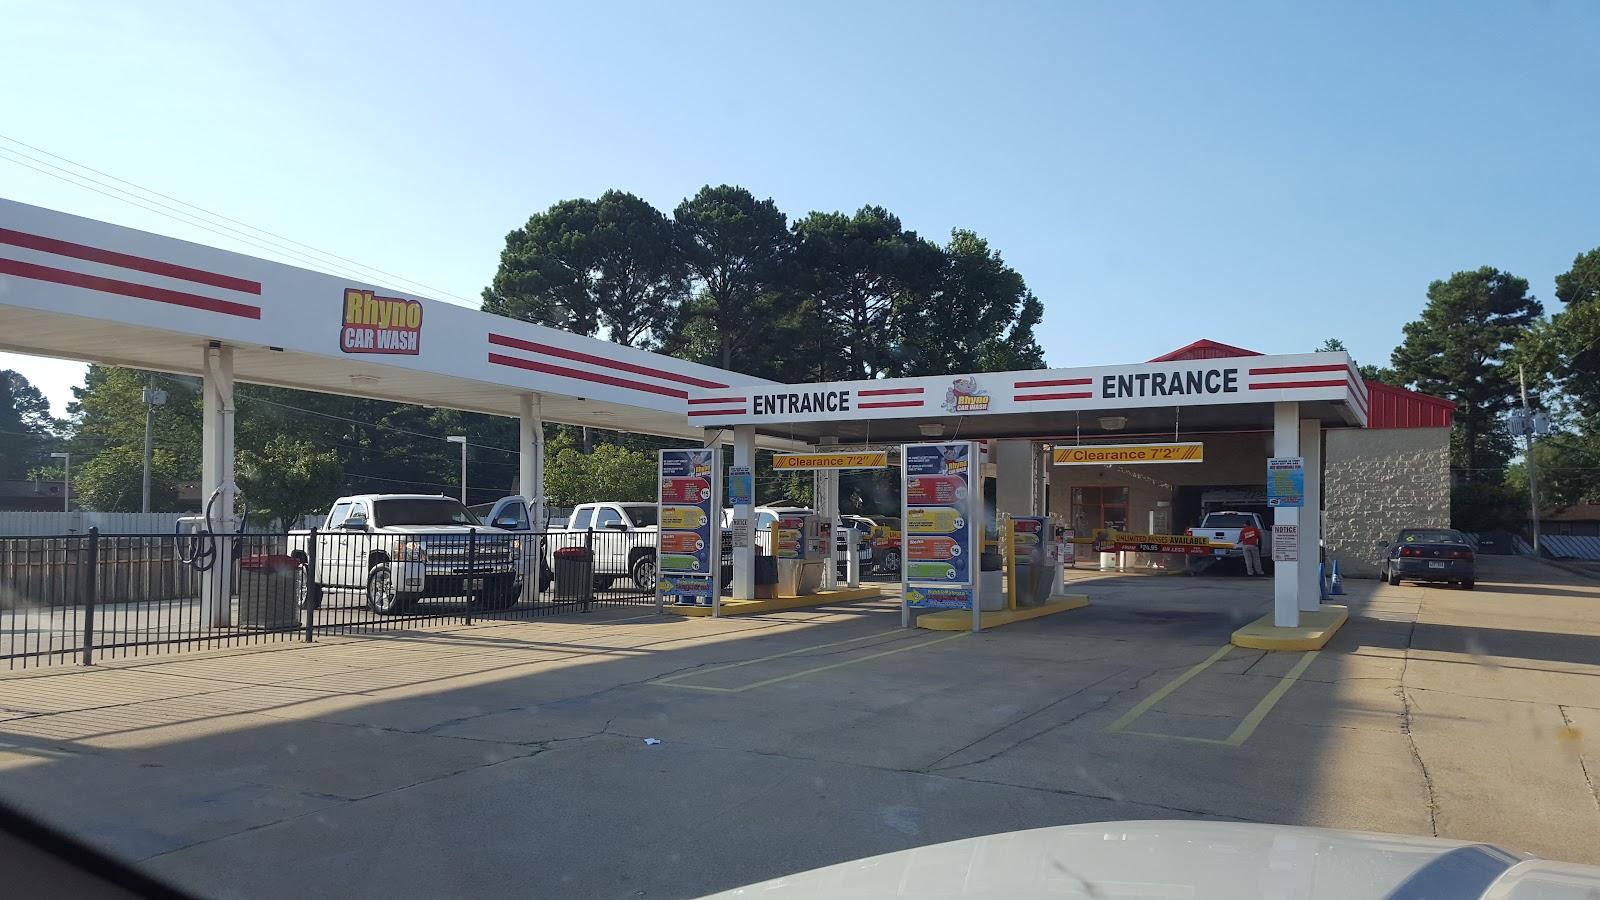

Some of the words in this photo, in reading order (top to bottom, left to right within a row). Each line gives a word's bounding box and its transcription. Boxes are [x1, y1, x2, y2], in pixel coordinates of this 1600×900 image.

[346, 291, 420, 329] Rhyno
[345, 327, 374, 349] CAR
[376, 329, 417, 351] WASH
[1102, 368, 1238, 399] ENTRANCE
[753, 390, 850, 415] ENTRANCE
[957, 395, 989, 405] Rhyno
[788, 457, 844, 467] Clearance
[1073, 449, 1146, 461] Clearance
[1274, 526, 1297, 534] NOTICE
